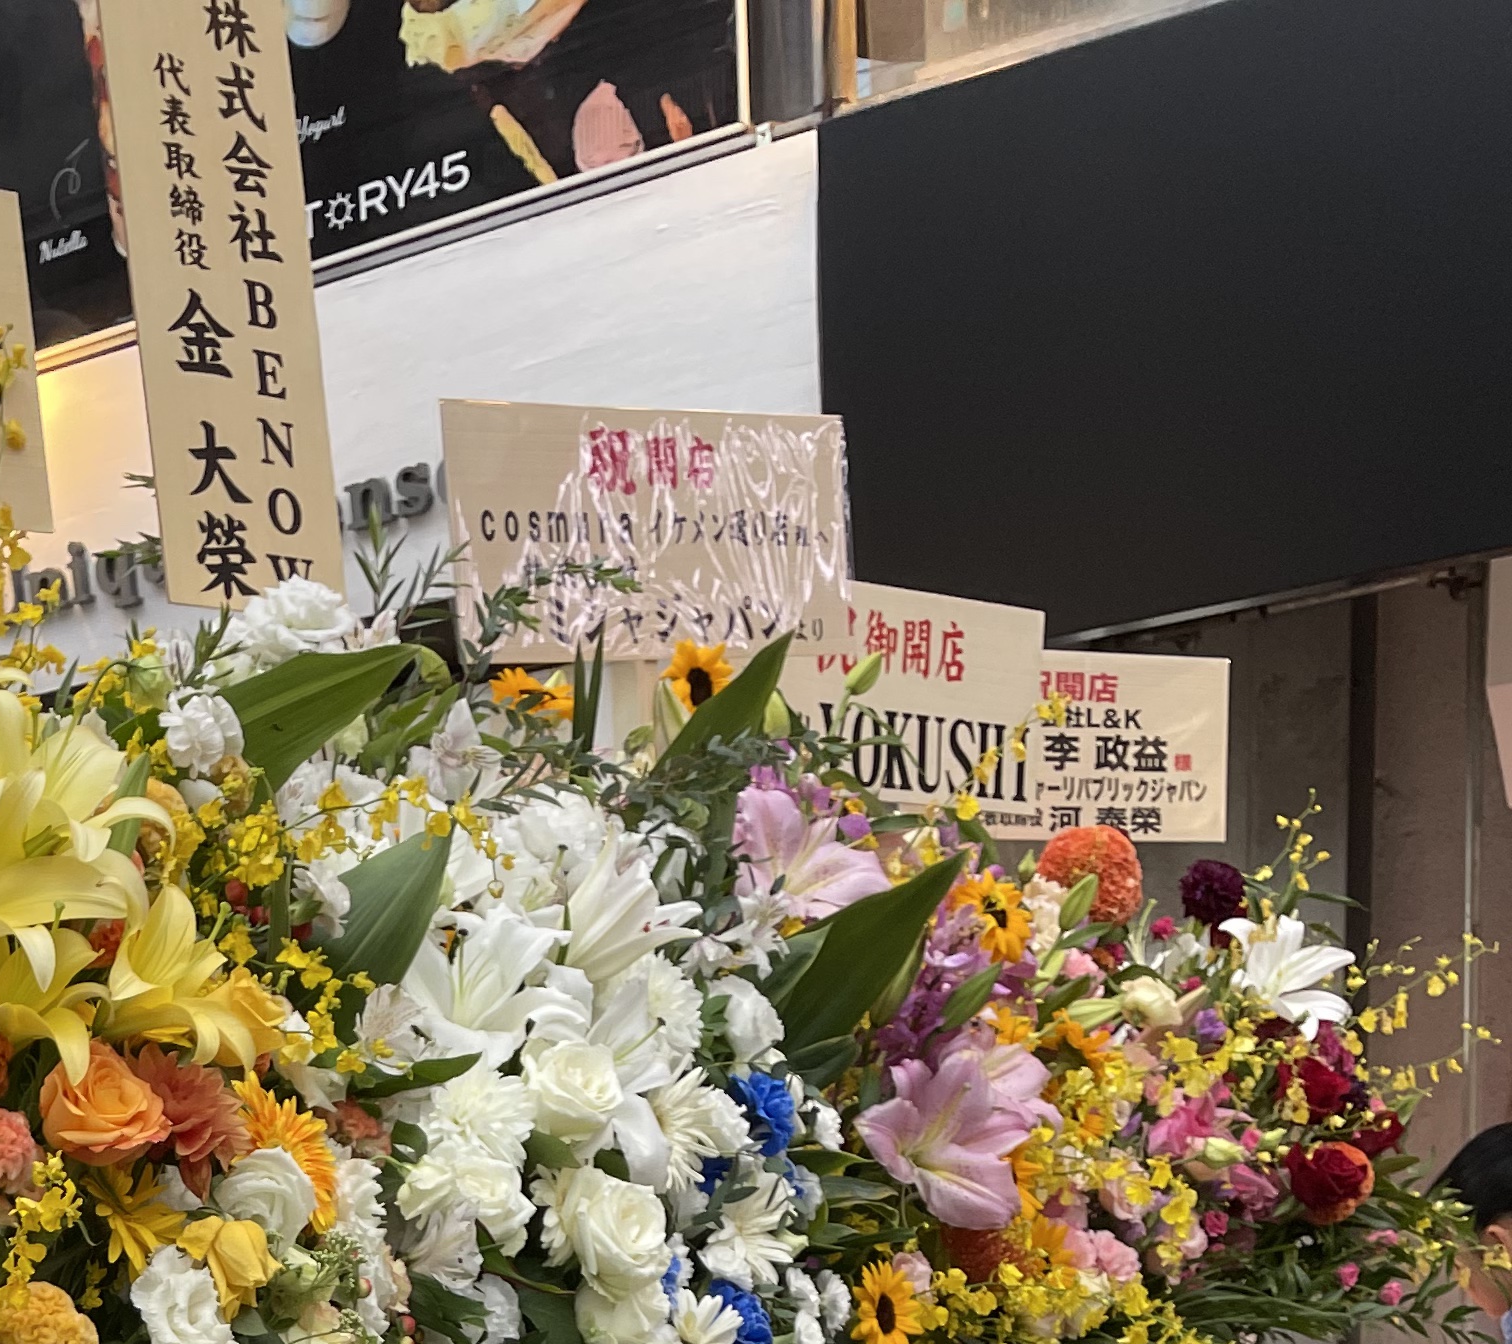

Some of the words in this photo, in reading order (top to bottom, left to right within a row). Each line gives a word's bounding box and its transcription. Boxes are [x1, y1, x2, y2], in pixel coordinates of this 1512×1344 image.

[153, 52, 211, 271] 代表取締役
[166, 288, 235, 379] 金
